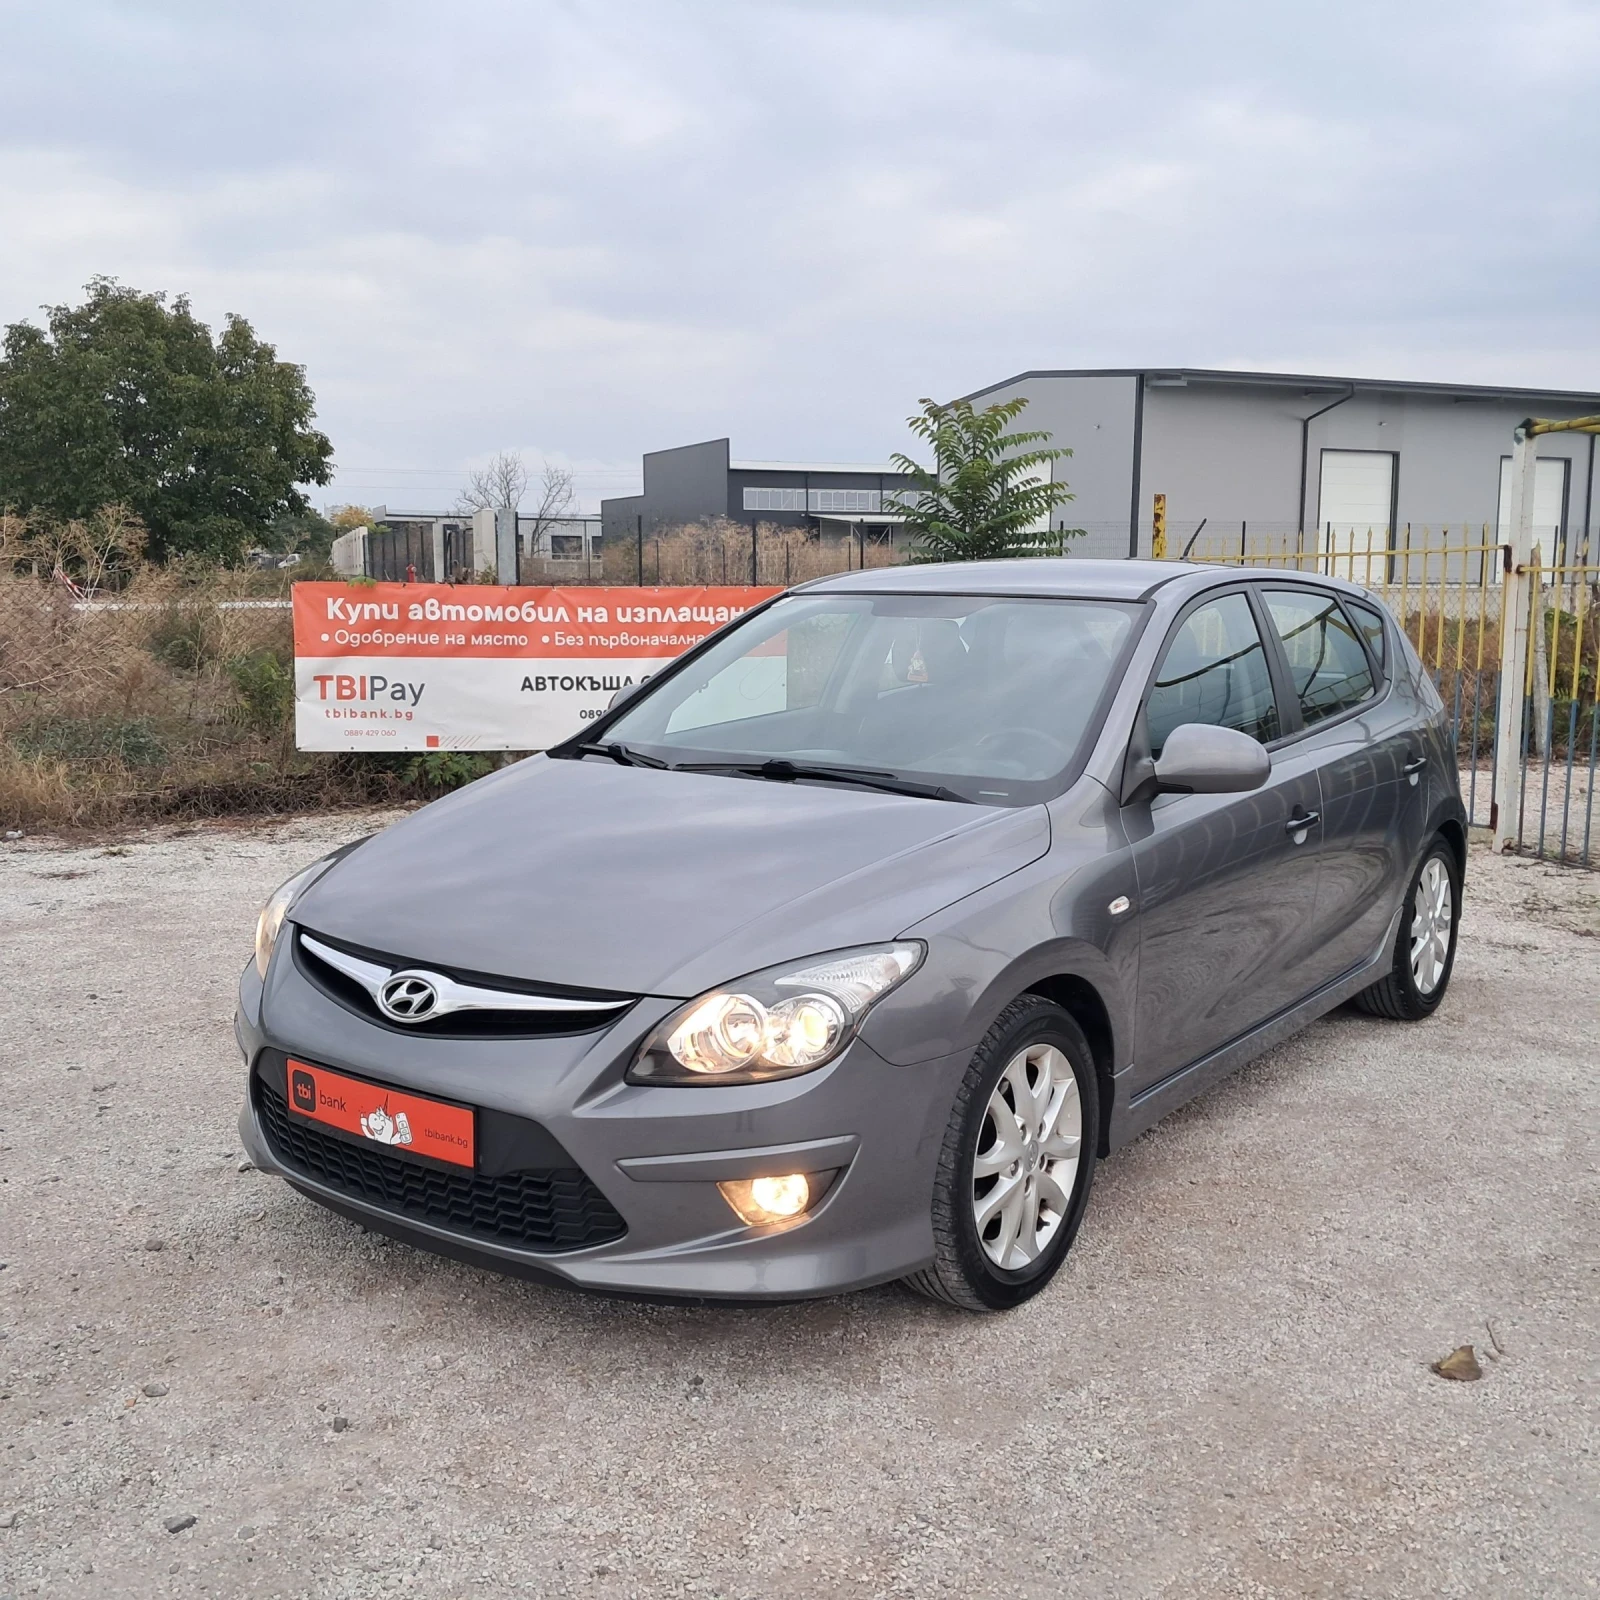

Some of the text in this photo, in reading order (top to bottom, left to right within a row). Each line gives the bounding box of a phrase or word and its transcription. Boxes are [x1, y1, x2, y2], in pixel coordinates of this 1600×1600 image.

[326, 597, 754, 625] Купи автомобил на изплащан
[334, 628, 439, 647] Одобрение
[445, 633, 465, 645] на
[471, 634, 528, 646] място
[554, 631, 584, 646] Без
[313, 675, 425, 707] TBIPay
[325, 708, 414, 721] tbibank.bg
[579, 709, 607, 719] 089
[344, 729, 396, 737] 0889 429 060
[296, 1083, 347, 1112] tbi bank
[424, 1127, 468, 1149] tbibank.bg
